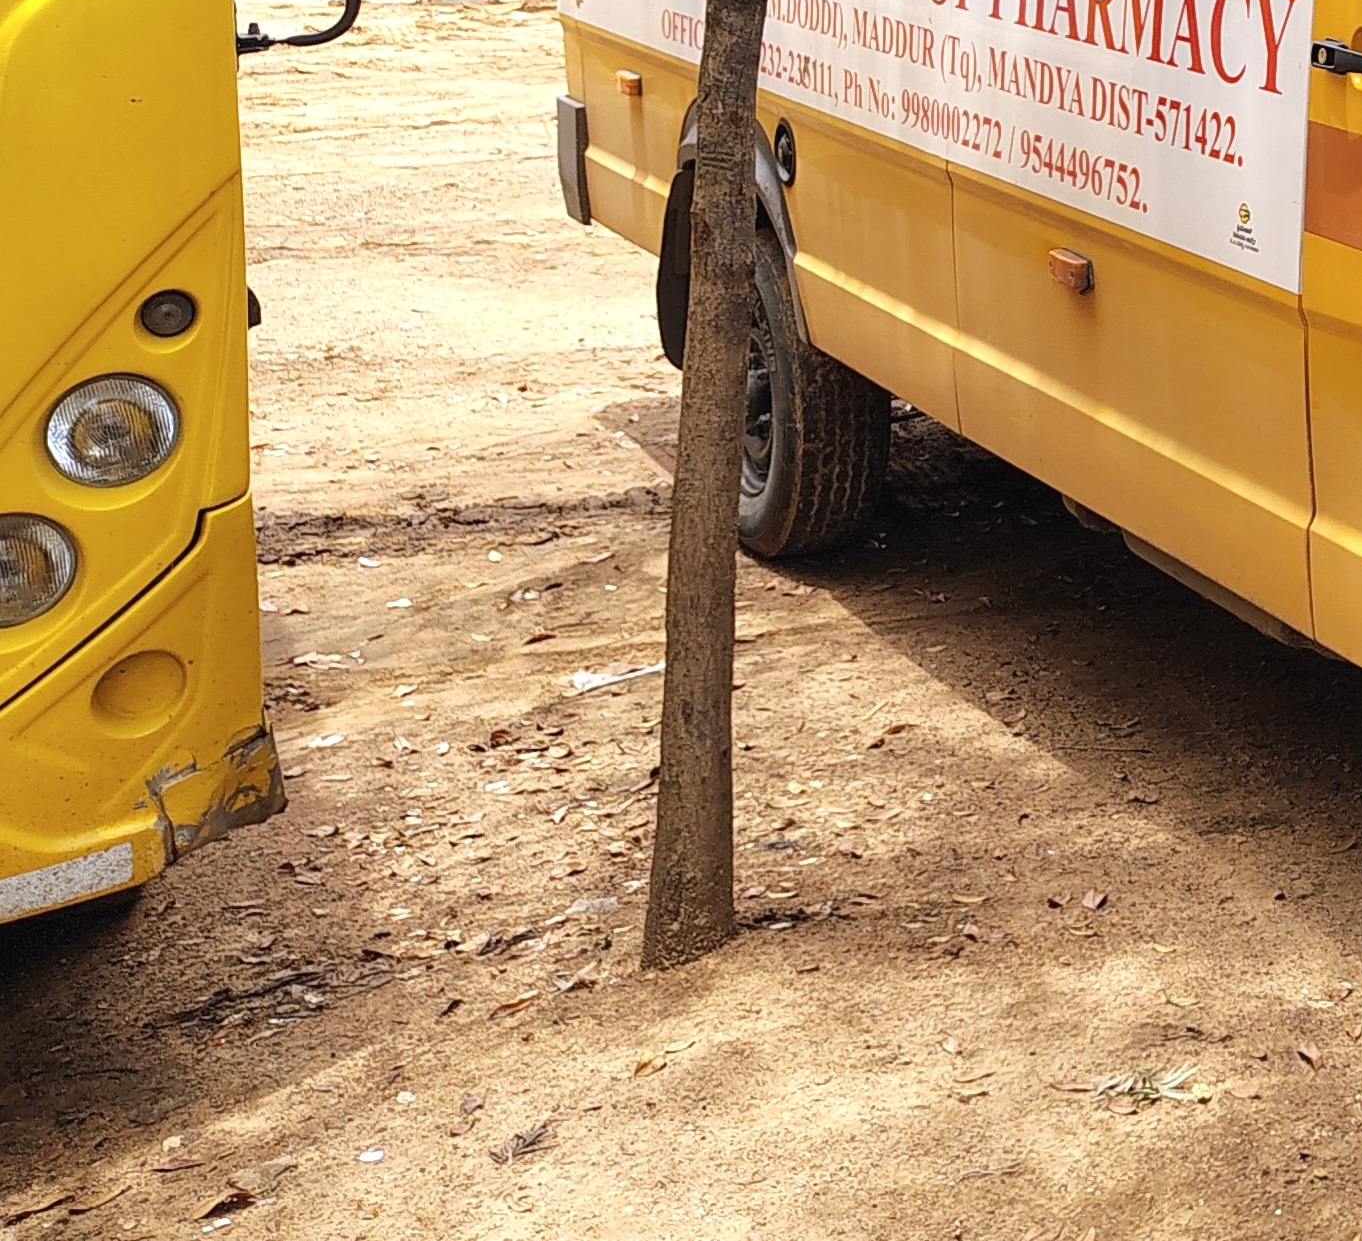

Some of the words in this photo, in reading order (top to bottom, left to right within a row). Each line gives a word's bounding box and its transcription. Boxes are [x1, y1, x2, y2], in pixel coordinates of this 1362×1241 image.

[661, 8, 703, 51] OFFIC
[843, 67, 863, 109] Ph
[868, 76, 896, 121] No:
[901, 88, 1003, 161] 9980002272
[1008, 125, 1016, 164] /
[1020, 129, 1149, 214] 9544496752.
[852, 7, 935, 69] MADDUR
[940, 34, 983, 93] (Tq),
[987, 47, 1086, 118] MANDYA
[1090, 76, 1243, 168] DIST-571422.
